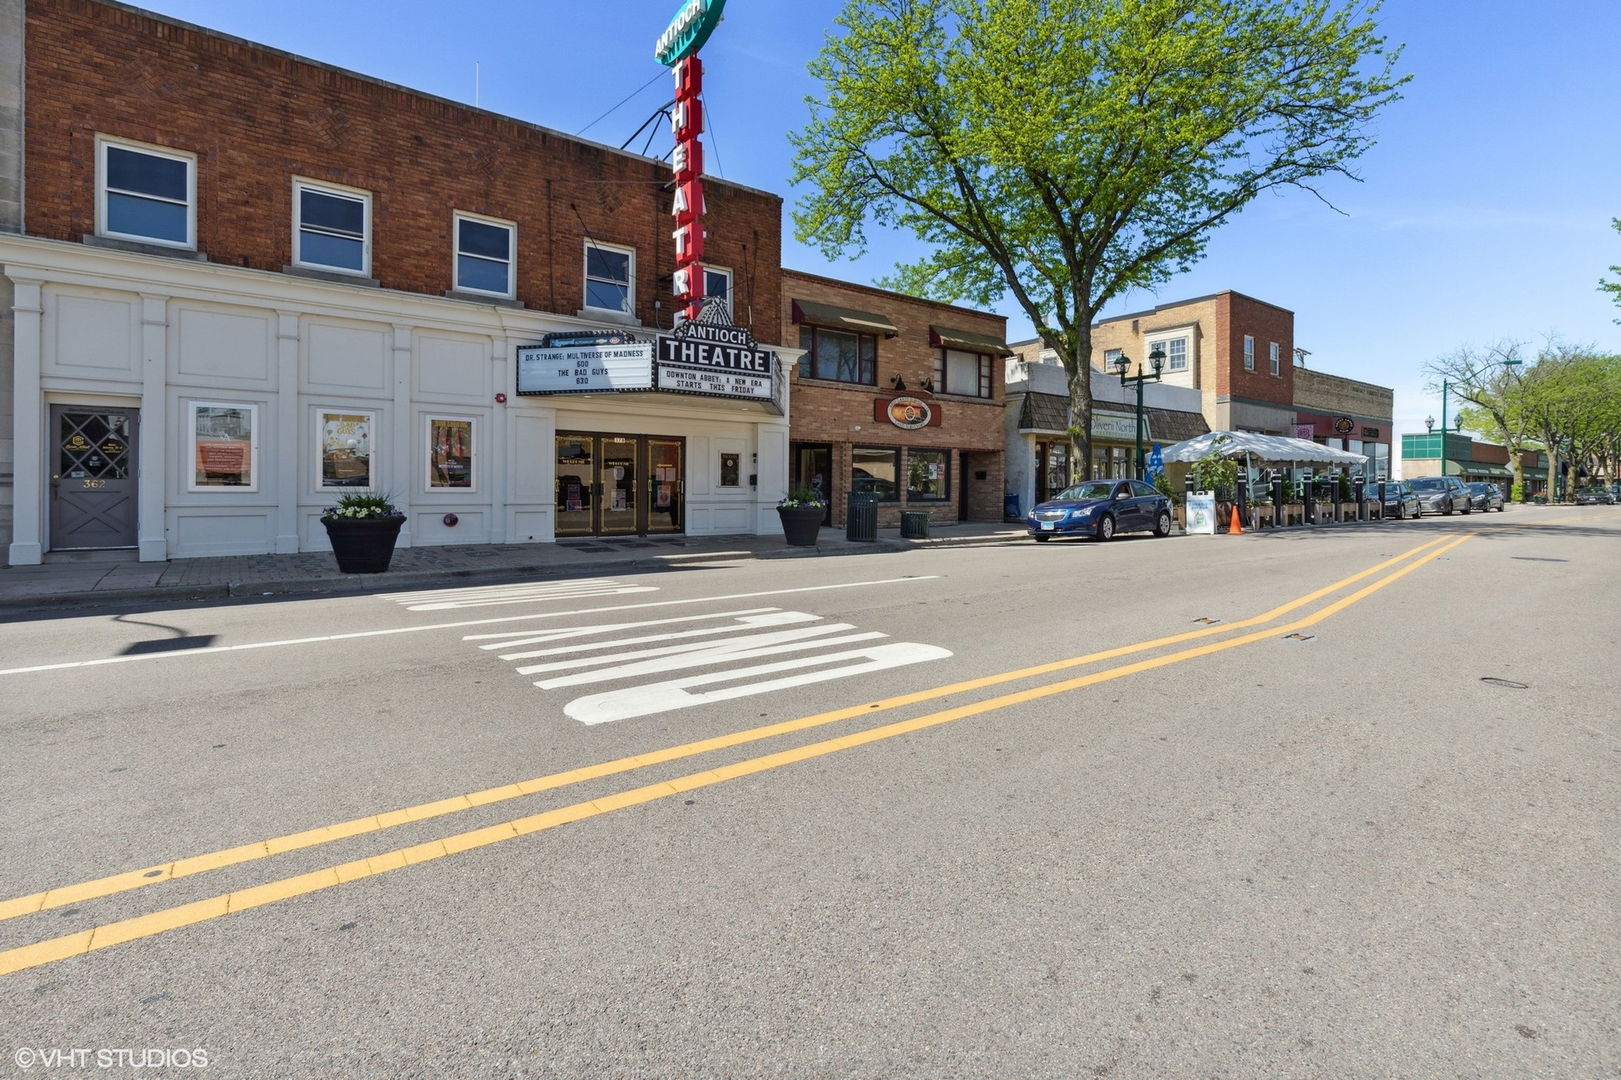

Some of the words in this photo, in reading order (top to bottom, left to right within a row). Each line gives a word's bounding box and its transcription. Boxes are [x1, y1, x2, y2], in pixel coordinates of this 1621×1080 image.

[655, 0, 702, 58] ANTIOCH
[687, 324, 747, 345] ANTIOCH
[613, 350, 644, 358] MADNESS
[666, 340, 765, 371] THEATRE
[576, 360, 589, 368] 600
[558, 369, 569, 377] THE
[591, 368, 609, 376] GUYS
[666, 370, 697, 381] DOWNTON
[726, 377, 730, 385] A
[734, 378, 746, 386] NEW
[750, 379, 763, 388] ERA
[576, 377, 589, 385] 630
[676, 380, 702, 390] STARTS
[709, 383, 726, 392] THIS
[731, 385, 755, 395] FRIDAY
[1115, 419, 1136, 433] North
[83, 479, 106, 489] 362
